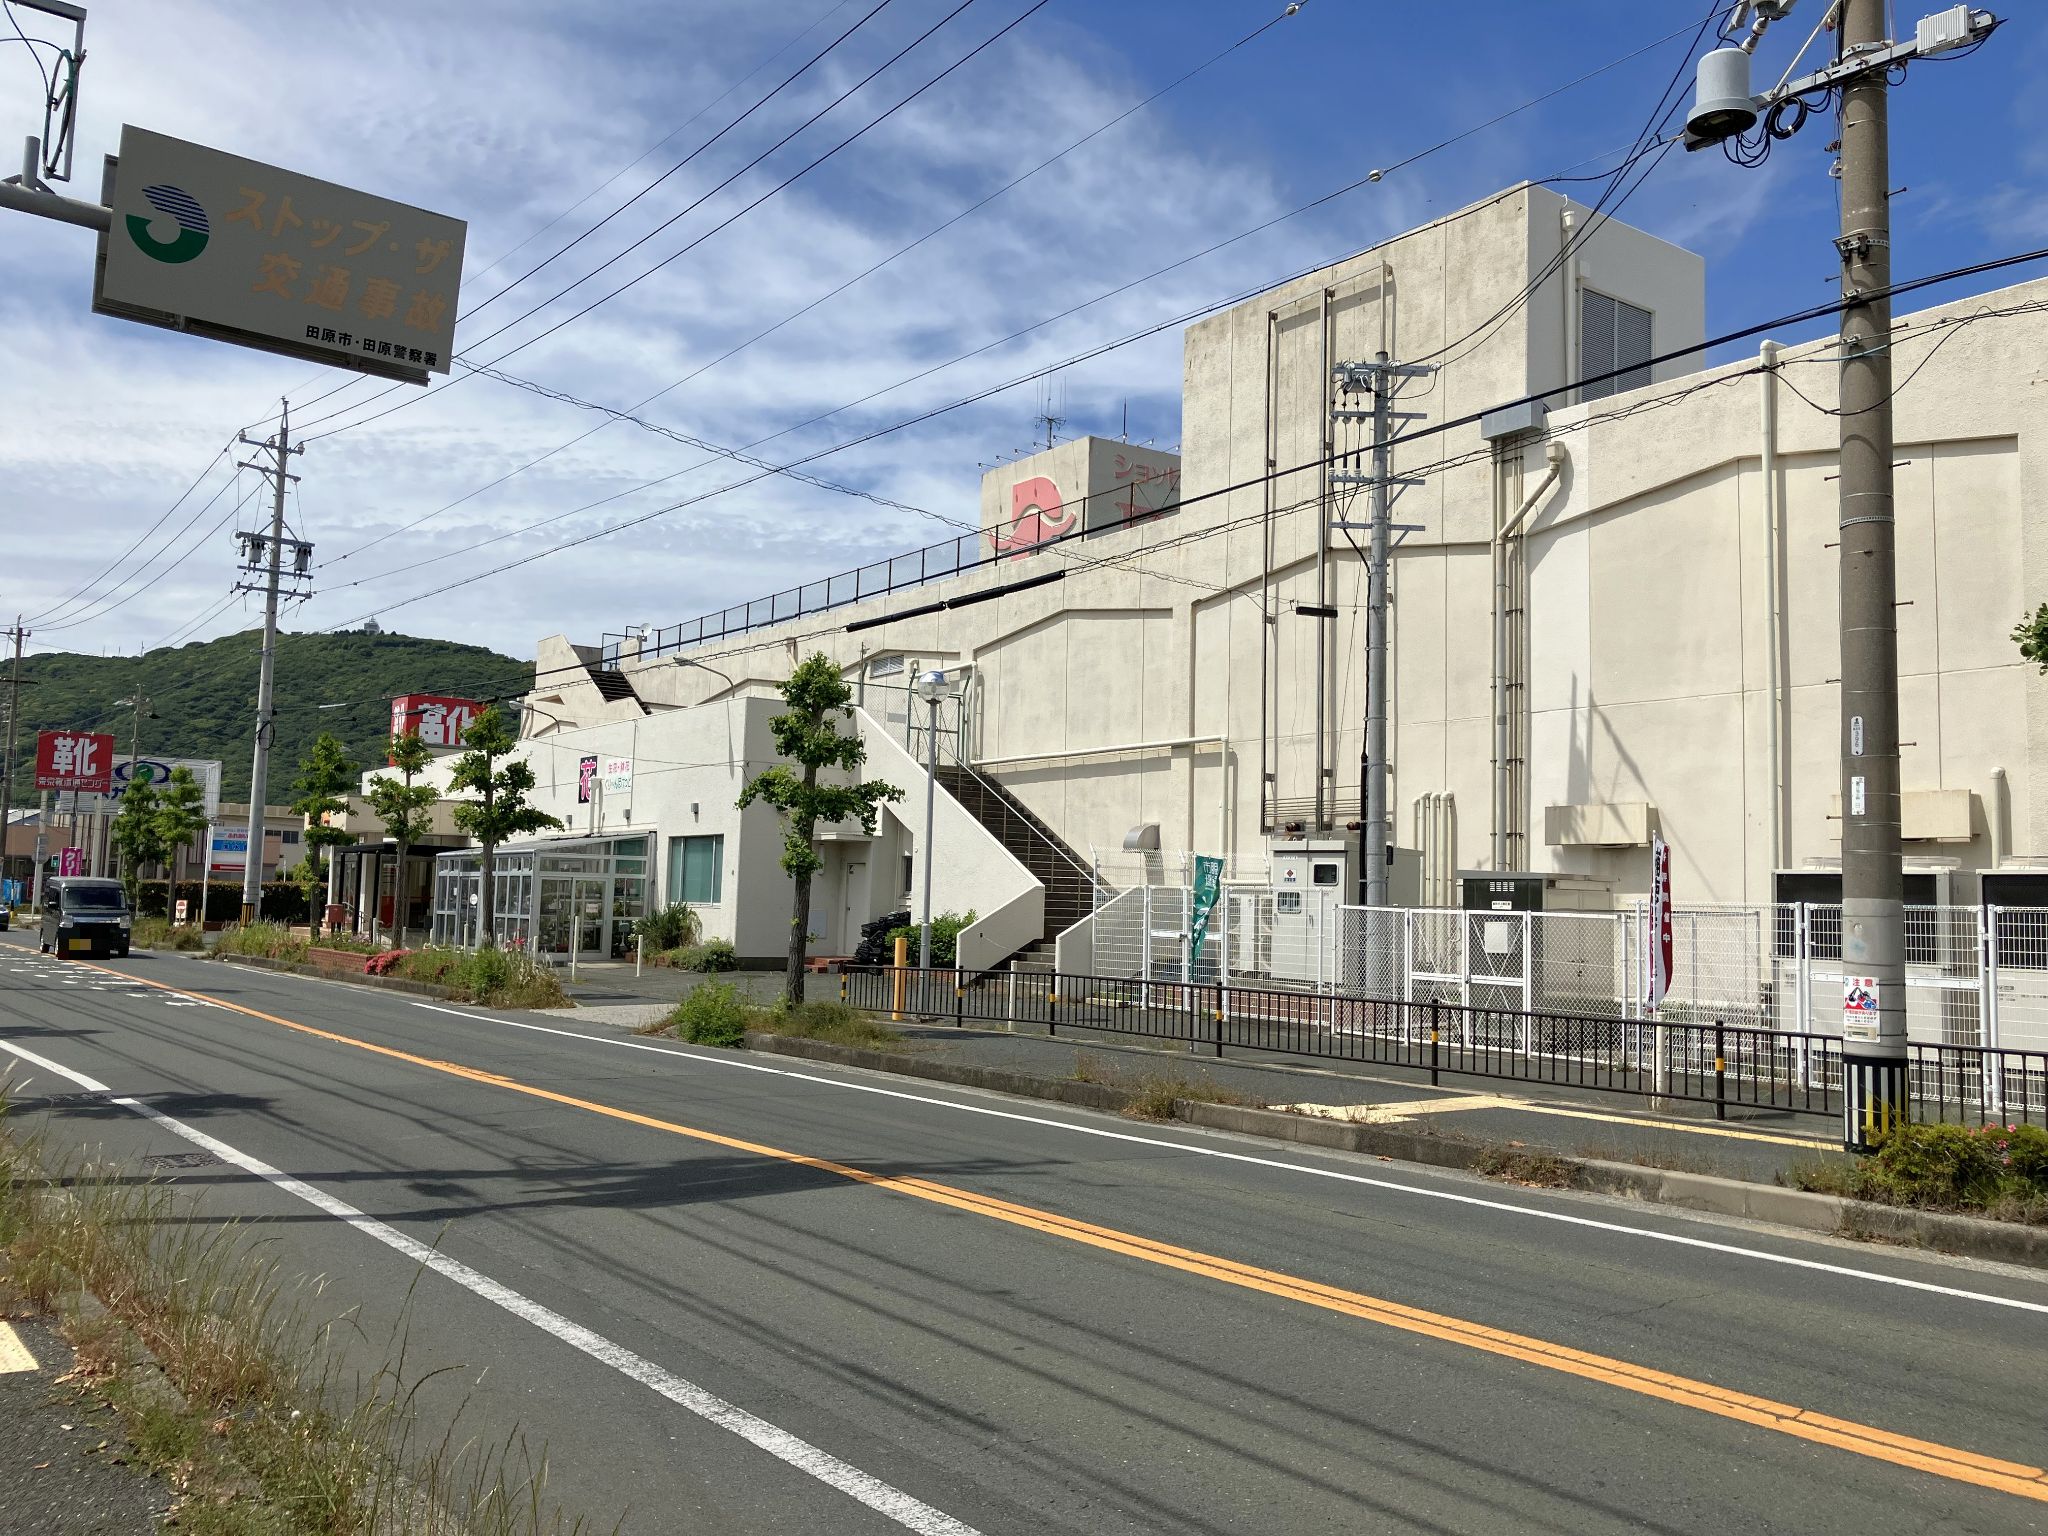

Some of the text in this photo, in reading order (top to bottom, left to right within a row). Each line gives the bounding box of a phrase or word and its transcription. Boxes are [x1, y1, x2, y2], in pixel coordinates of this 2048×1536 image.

[225, 188, 453, 273] ストップ・ザ
[252, 253, 446, 333] 交通事故
[306, 325, 437, 366] 田原市・田原警察署
[52, 736, 98, 776] 靴
